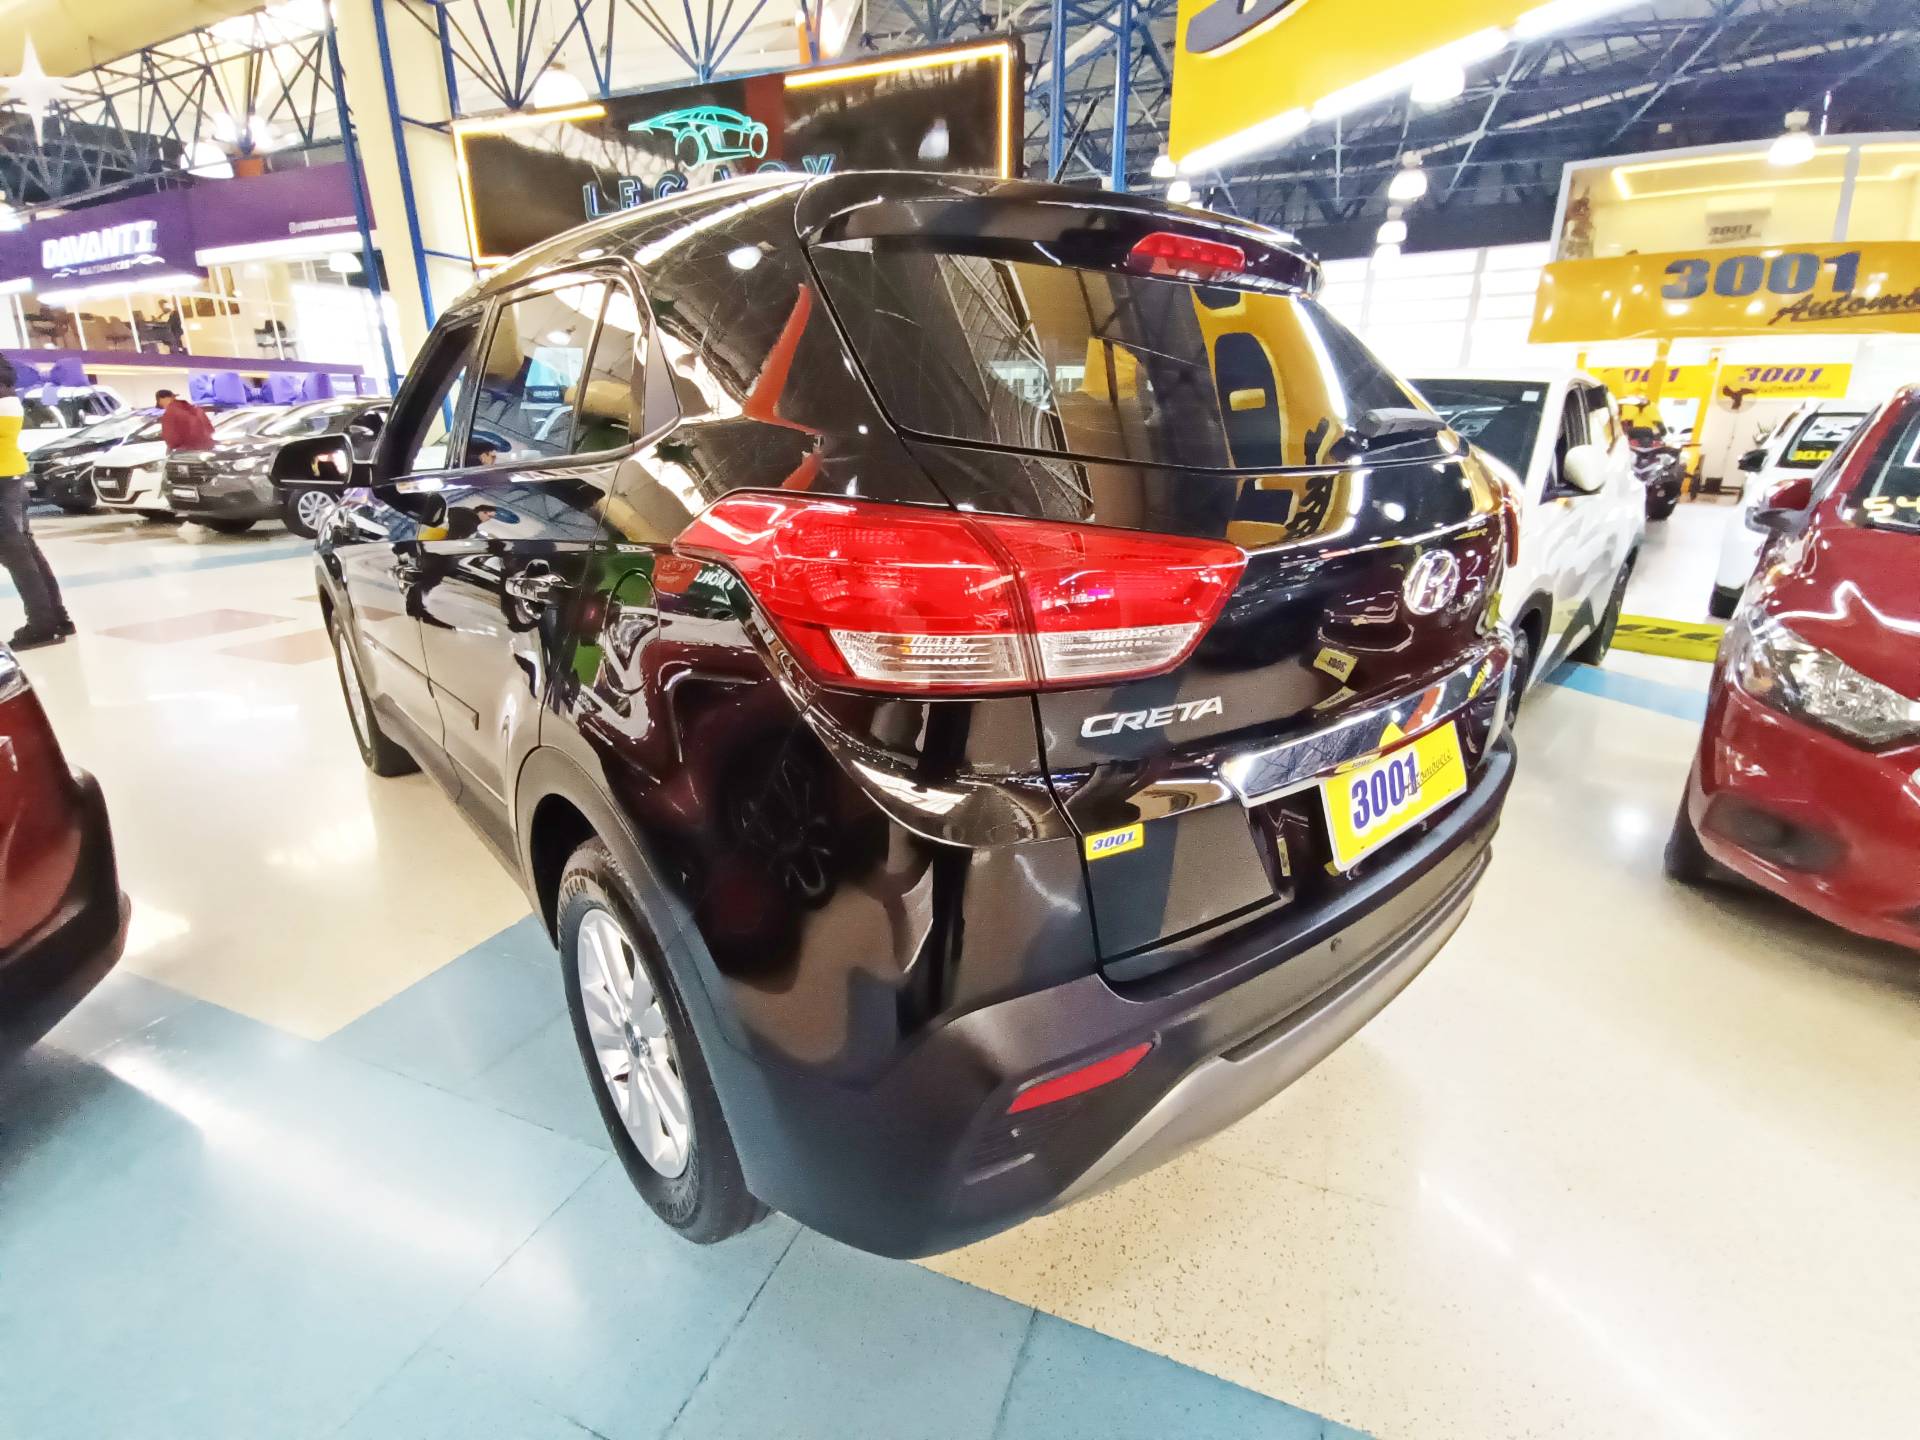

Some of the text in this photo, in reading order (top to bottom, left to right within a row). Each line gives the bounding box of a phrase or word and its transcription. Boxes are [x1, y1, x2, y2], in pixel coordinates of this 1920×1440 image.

[42, 220, 158, 269] DAVANTI
[1661, 250, 1861, 299] 3001
[1738, 367, 1824, 383] 3001
[1081, 696, 1224, 739] CRETA
[1352, 751, 1419, 830] 3001
[1092, 831, 1137, 851] 3001
